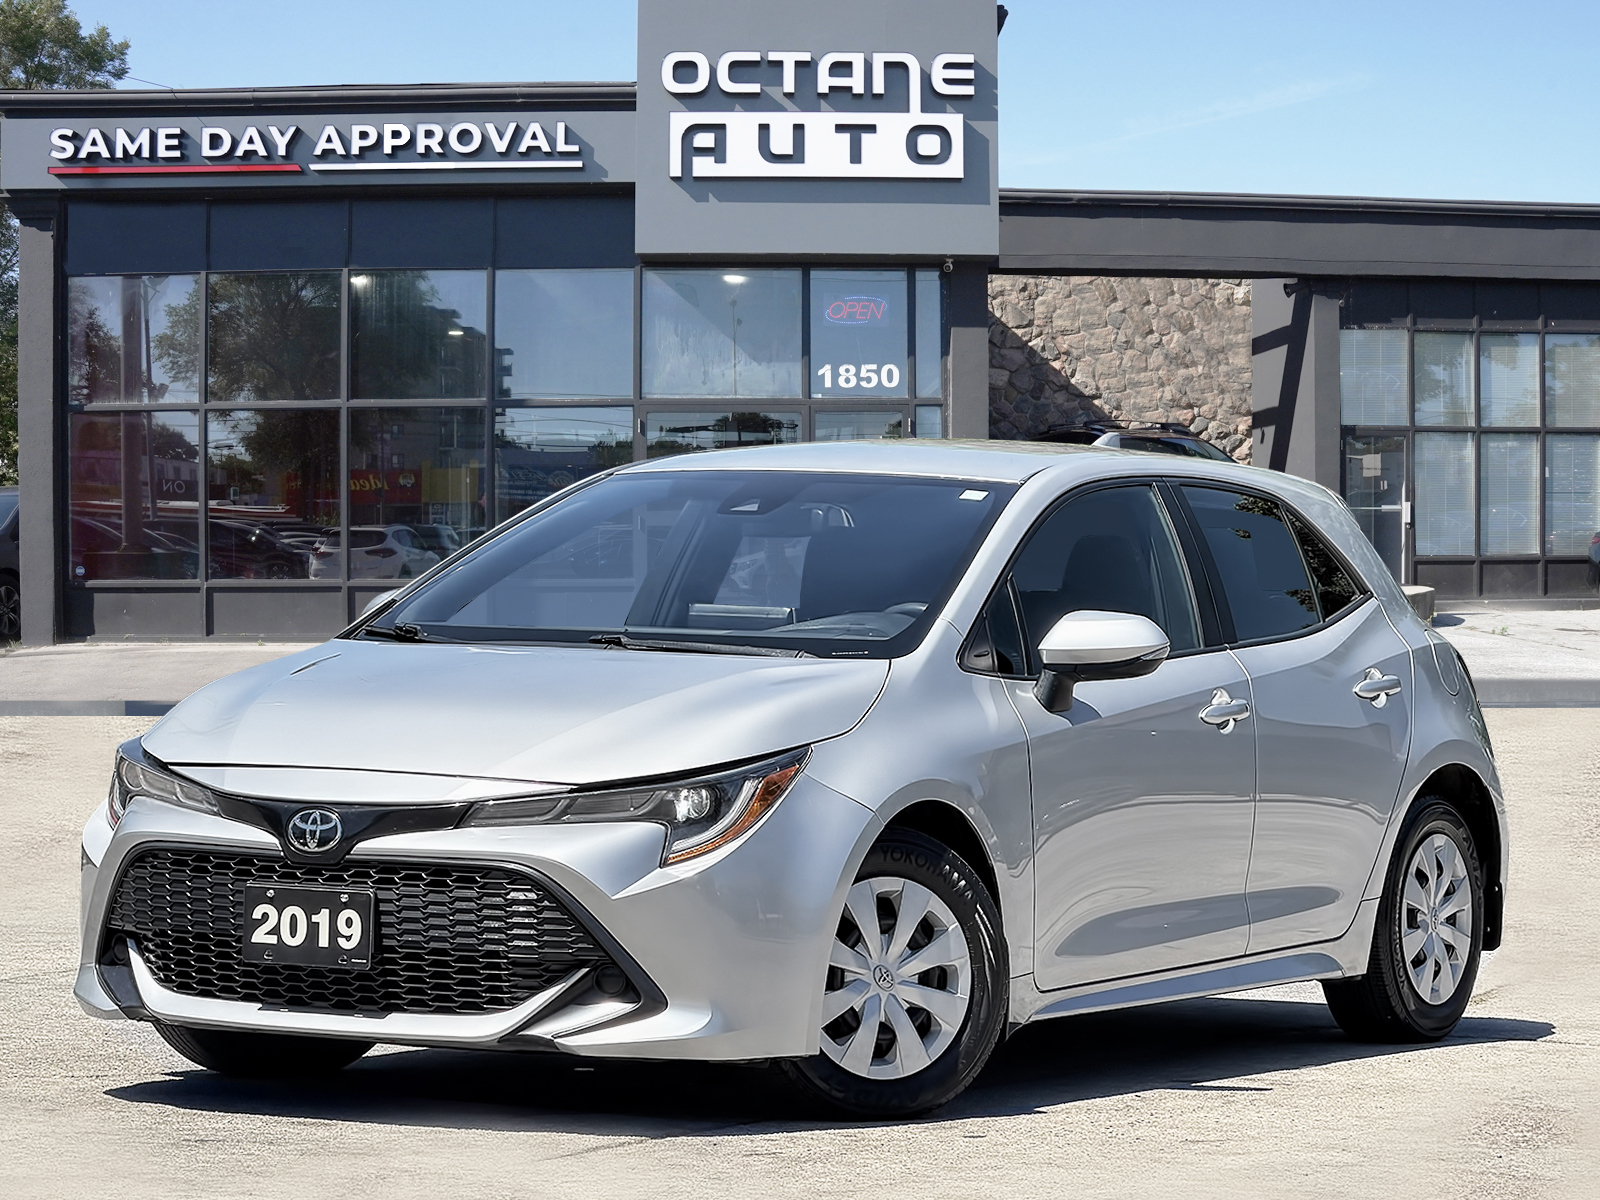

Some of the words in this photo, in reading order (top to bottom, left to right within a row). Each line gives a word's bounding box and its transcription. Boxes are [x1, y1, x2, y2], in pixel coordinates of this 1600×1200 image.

[661, 51, 975, 112] OCTANE
[49, 127, 181, 160] SAME
[201, 125, 298, 157] DAY
[313, 121, 580, 156] APPROVAL
[680, 122, 953, 177] AUTO
[829, 301, 885, 319] OPEN
[817, 364, 900, 388] 1850
[250, 903, 362, 950] 2019
